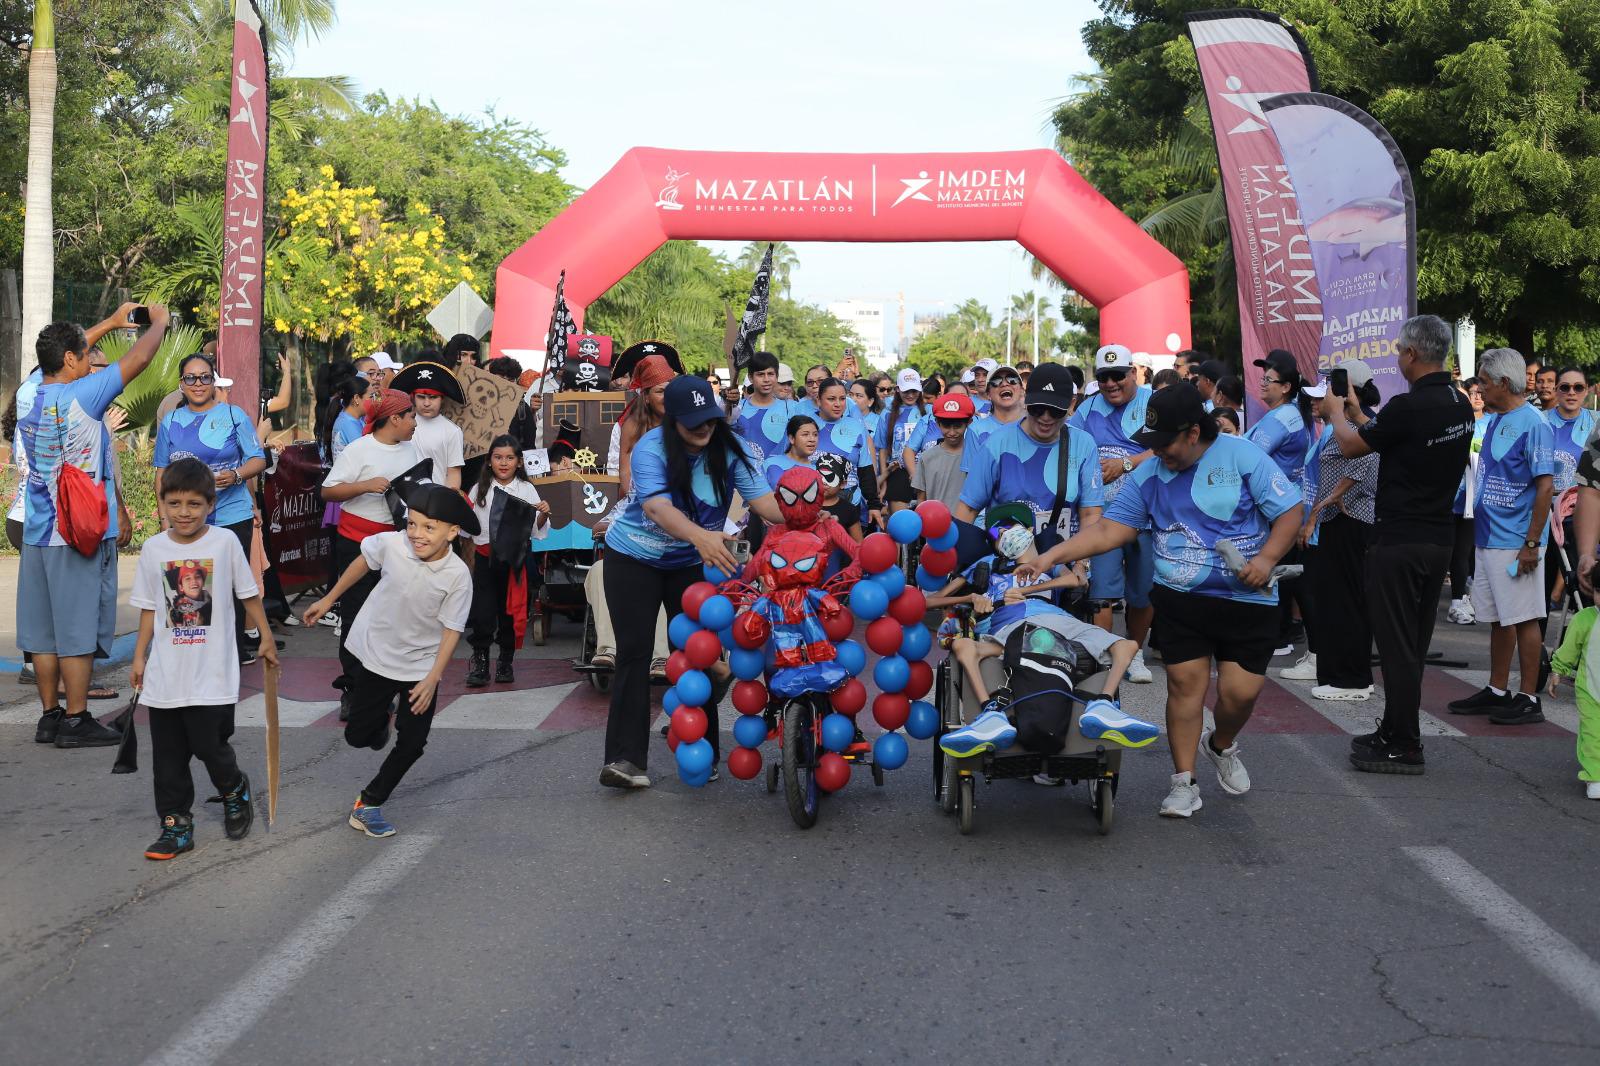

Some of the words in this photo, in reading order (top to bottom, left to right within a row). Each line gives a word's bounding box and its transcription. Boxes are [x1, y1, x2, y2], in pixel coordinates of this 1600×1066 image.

[938, 169, 1026, 188] IMDEM
[695, 176, 854, 201] MAZATLÁN
[937, 186, 1025, 202] MAZATLÁN
[695, 204, 766, 213] BIENESTAR
[772, 205, 805, 213] PARA
[811, 205, 854, 213] TODOS
[691, 390, 706, 407] LA
[283, 492, 320, 519] MAZATL
[172, 627, 206, 638] Brayan
